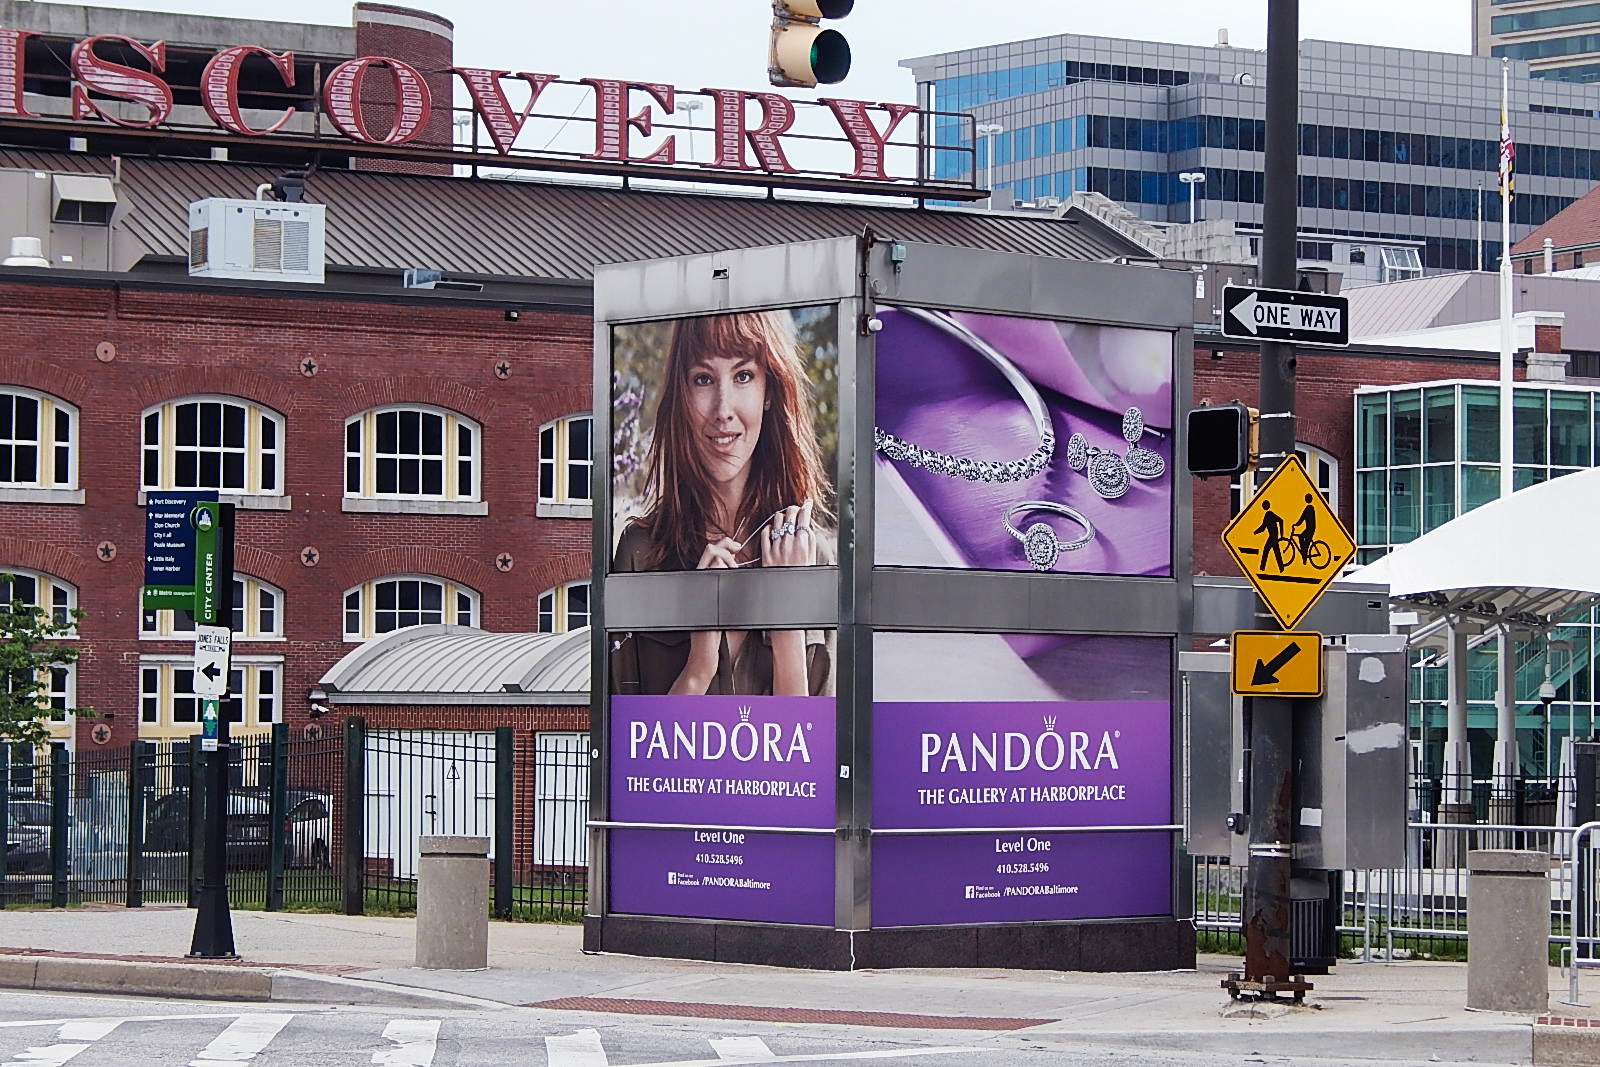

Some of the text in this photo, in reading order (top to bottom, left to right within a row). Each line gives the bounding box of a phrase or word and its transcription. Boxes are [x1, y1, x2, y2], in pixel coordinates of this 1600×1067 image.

[1254, 304, 1337, 329] ONE WAY
[198, 634, 228, 645] JONES FALLS
[627, 777, 816, 798] THE GALLERY AT HARBORPLACE
[918, 785, 1126, 805] THE GALLERY AT HARBORPLACE
[694, 831, 745, 844] Level One
[996, 836, 1051, 852] Level One
[696, 853, 743, 865] 410.528.5496
[997, 863, 1049, 873] 410.528.5496
[702, 876, 771, 889] /PANDORABaltimore
[1004, 884, 1078, 897] /PANDORABaltimore
